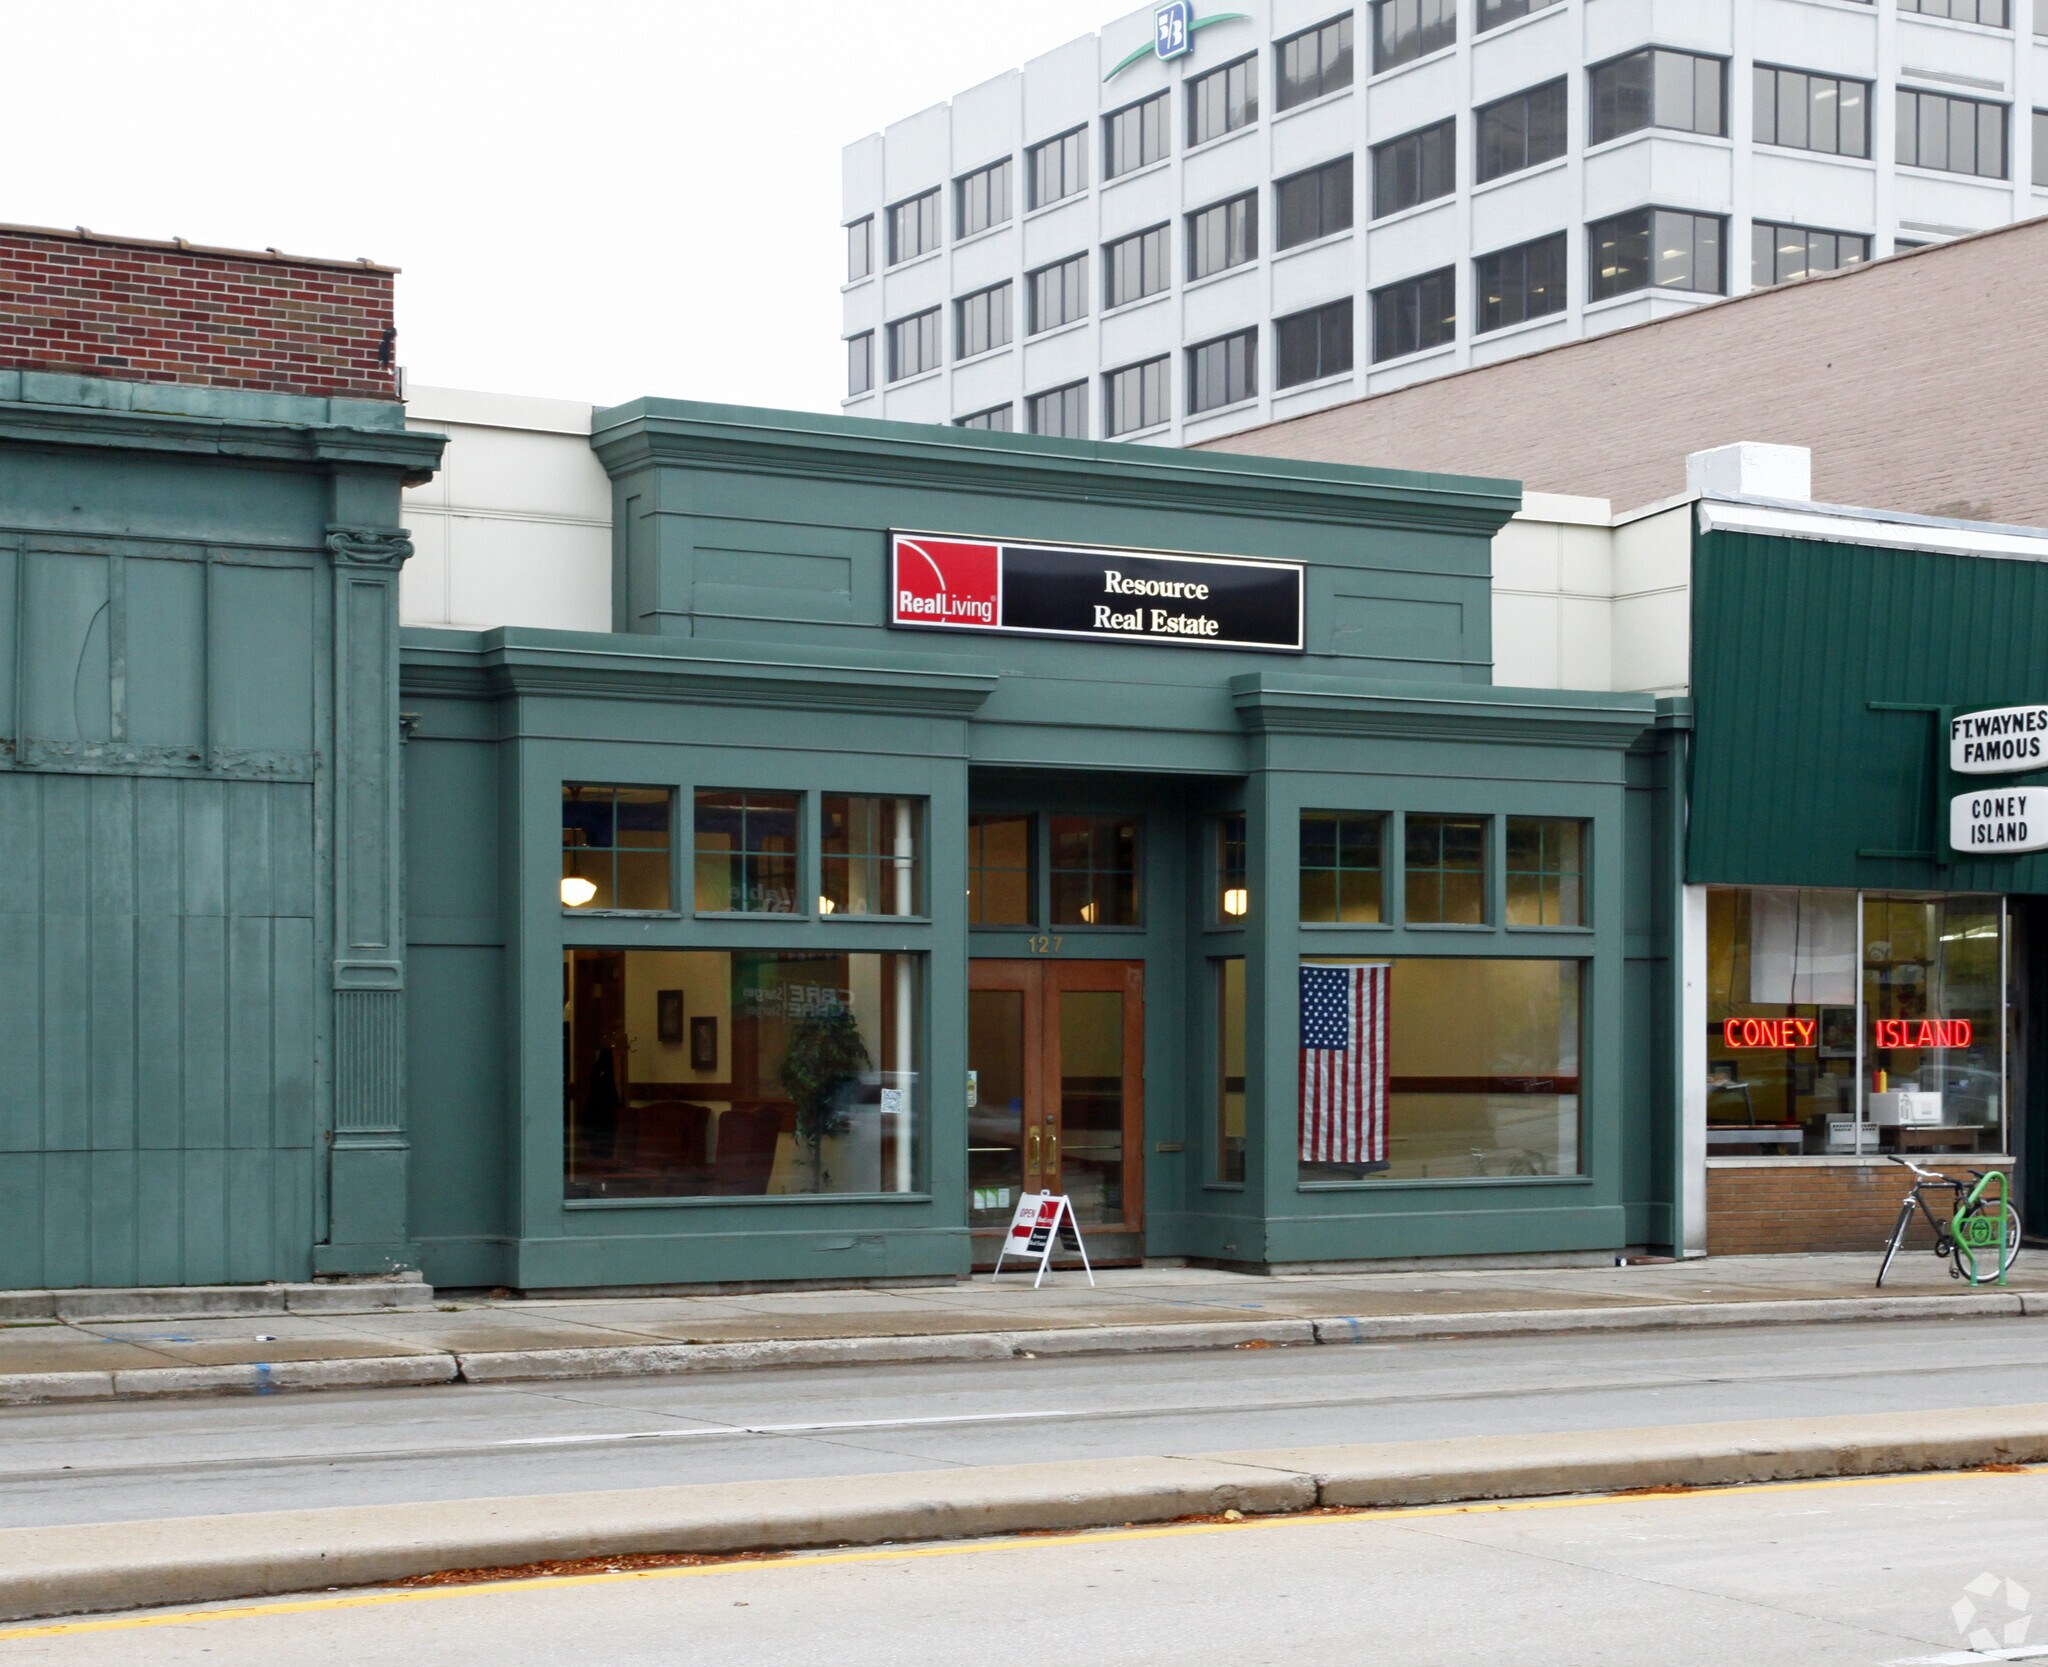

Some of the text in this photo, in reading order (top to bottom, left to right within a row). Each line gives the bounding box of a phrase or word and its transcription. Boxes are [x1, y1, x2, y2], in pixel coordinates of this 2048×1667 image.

[1104, 570, 1209, 600] Resource
[1093, 605, 1219, 636] Real Estate
[1964, 736, 2040, 763] FAMOUS
[1972, 796, 2027, 819] CONEY
[1971, 821, 2028, 845] ISLAND
[1028, 935, 1063, 953] 127
[1725, 1019, 1972, 1048] CONEY ISLAND
[1019, 1208, 1037, 1218] OPEN
